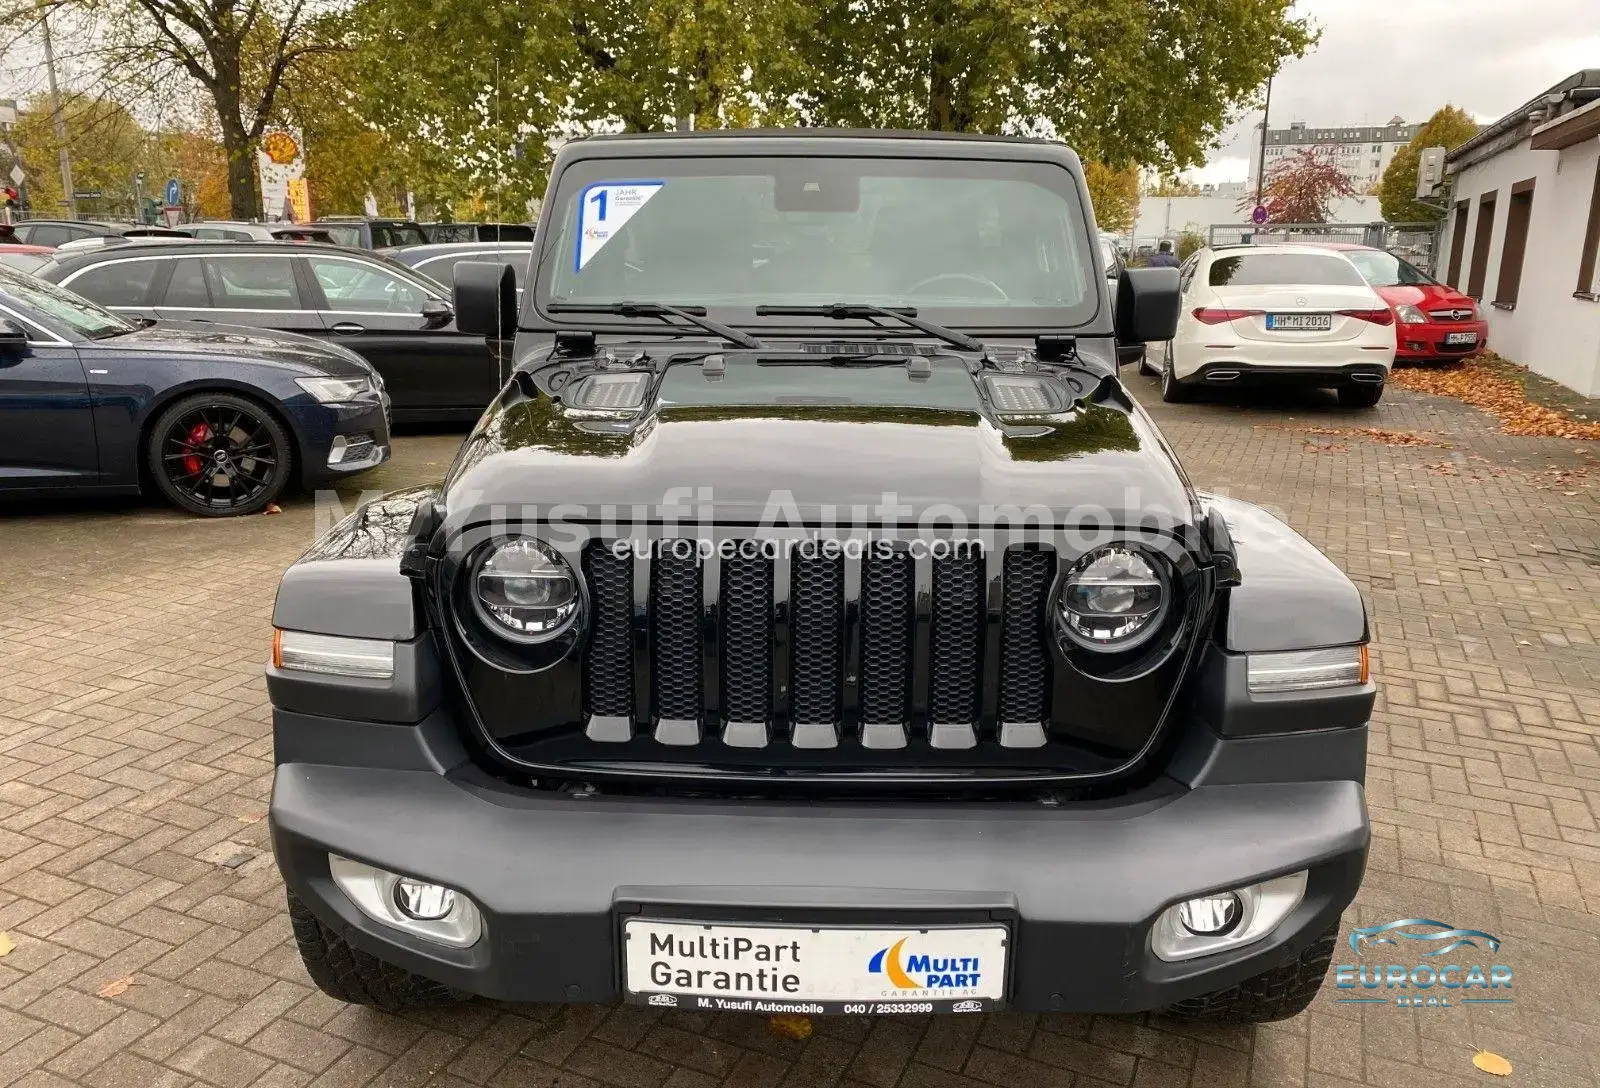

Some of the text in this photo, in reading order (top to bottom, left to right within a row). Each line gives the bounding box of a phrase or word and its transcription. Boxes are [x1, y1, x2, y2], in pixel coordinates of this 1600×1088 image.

[615, 189, 637, 197] JAHR
[590, 190, 608, 221] 1
[1273, 315, 1329, 326] HH MI 2016
[649, 932, 801, 963] MultiPart
[906, 955, 979, 973] MULTI
[650, 961, 801, 993] Garantie
[926, 973, 981, 988] PART
[881, 988, 955, 997] GARANTIE
[697, 997, 713, 1009] M.
[715, 998, 752, 1011] Yusufi
[755, 1000, 824, 1014] Automobile
[844, 1004, 866, 1013] 040
[876, 1003, 933, 1013] 25332999
